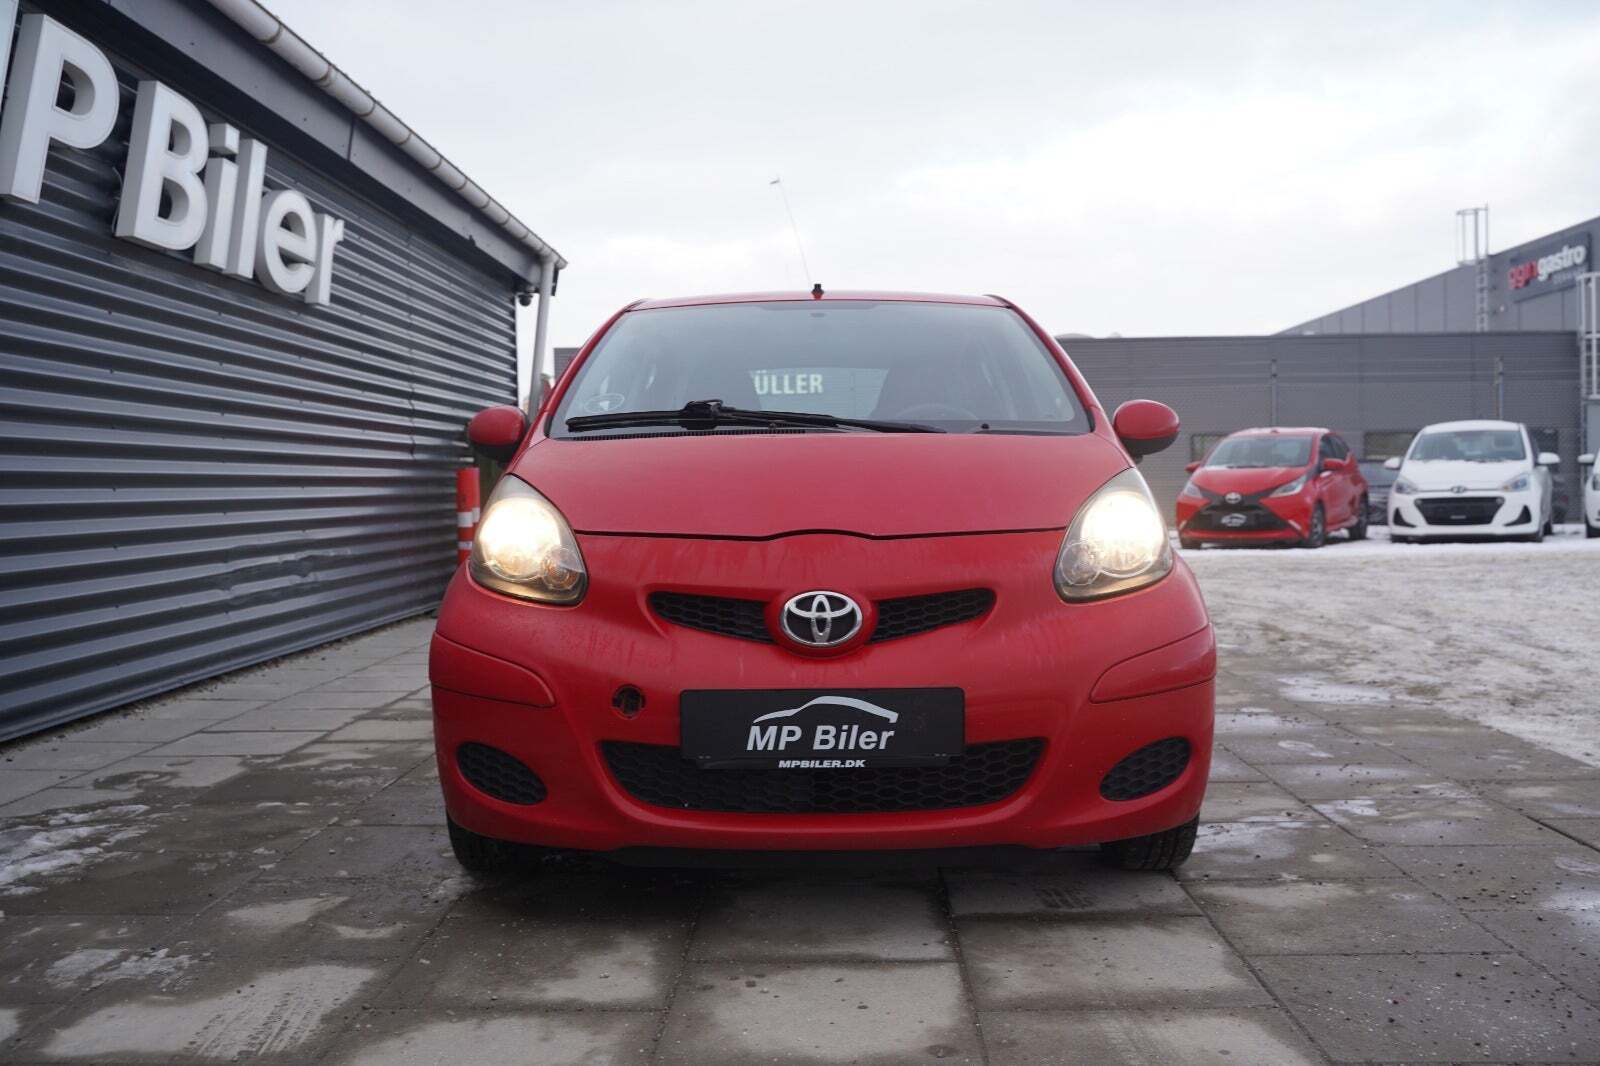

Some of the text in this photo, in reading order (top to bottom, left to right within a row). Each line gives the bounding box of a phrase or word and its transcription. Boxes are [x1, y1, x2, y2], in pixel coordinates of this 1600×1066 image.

[0, 0, 344, 306] P Biler
[747, 724, 894, 750] MP Biler
[778, 759, 866, 768] MPBILER.DK
